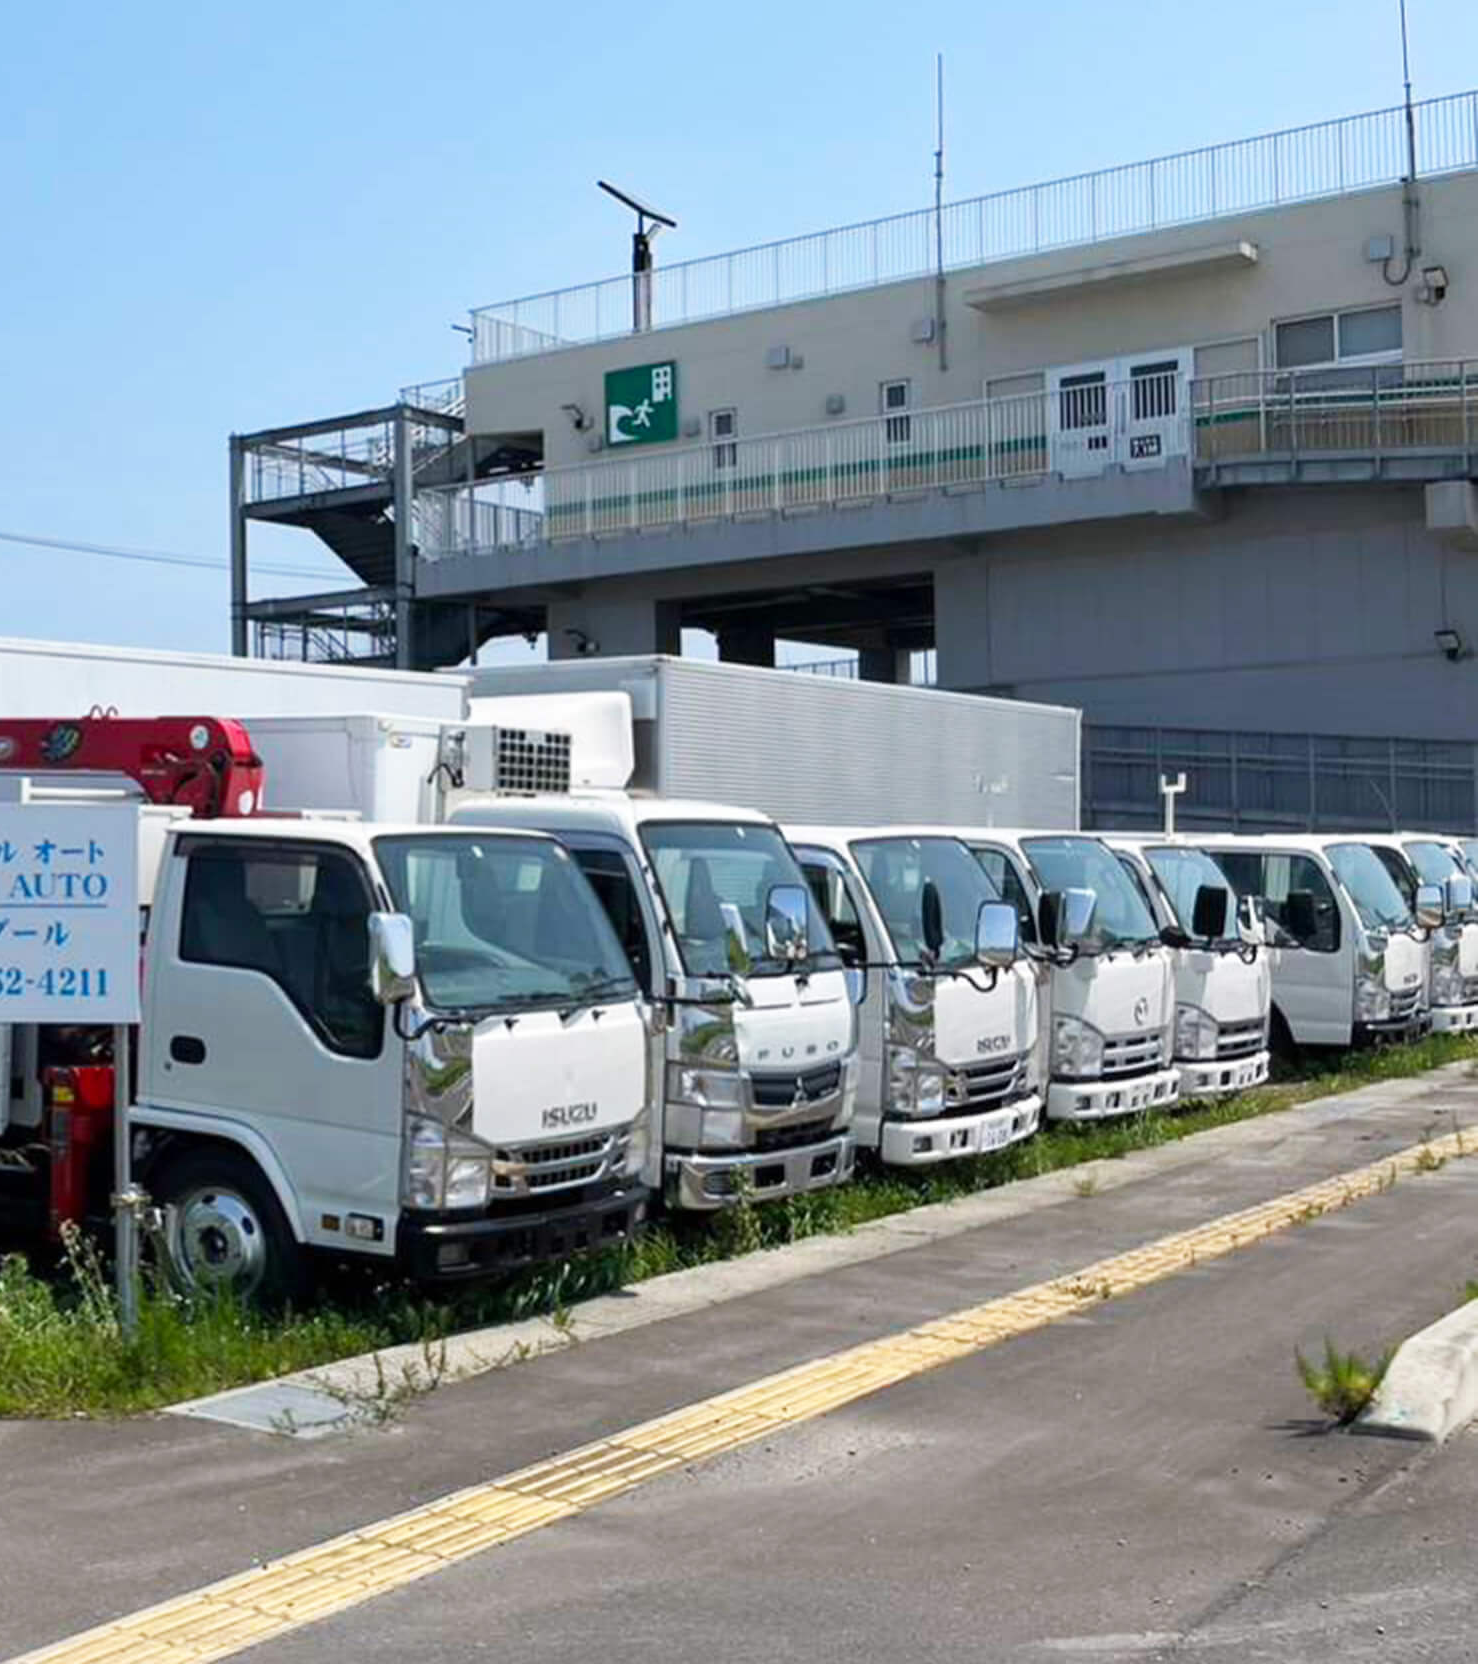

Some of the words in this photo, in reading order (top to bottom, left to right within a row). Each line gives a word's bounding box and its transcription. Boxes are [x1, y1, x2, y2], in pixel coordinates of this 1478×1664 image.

[33, 839, 104, 864] オート
[10, 872, 107, 899] AUTO
[541, 1101, 598, 1129] ISUZU
